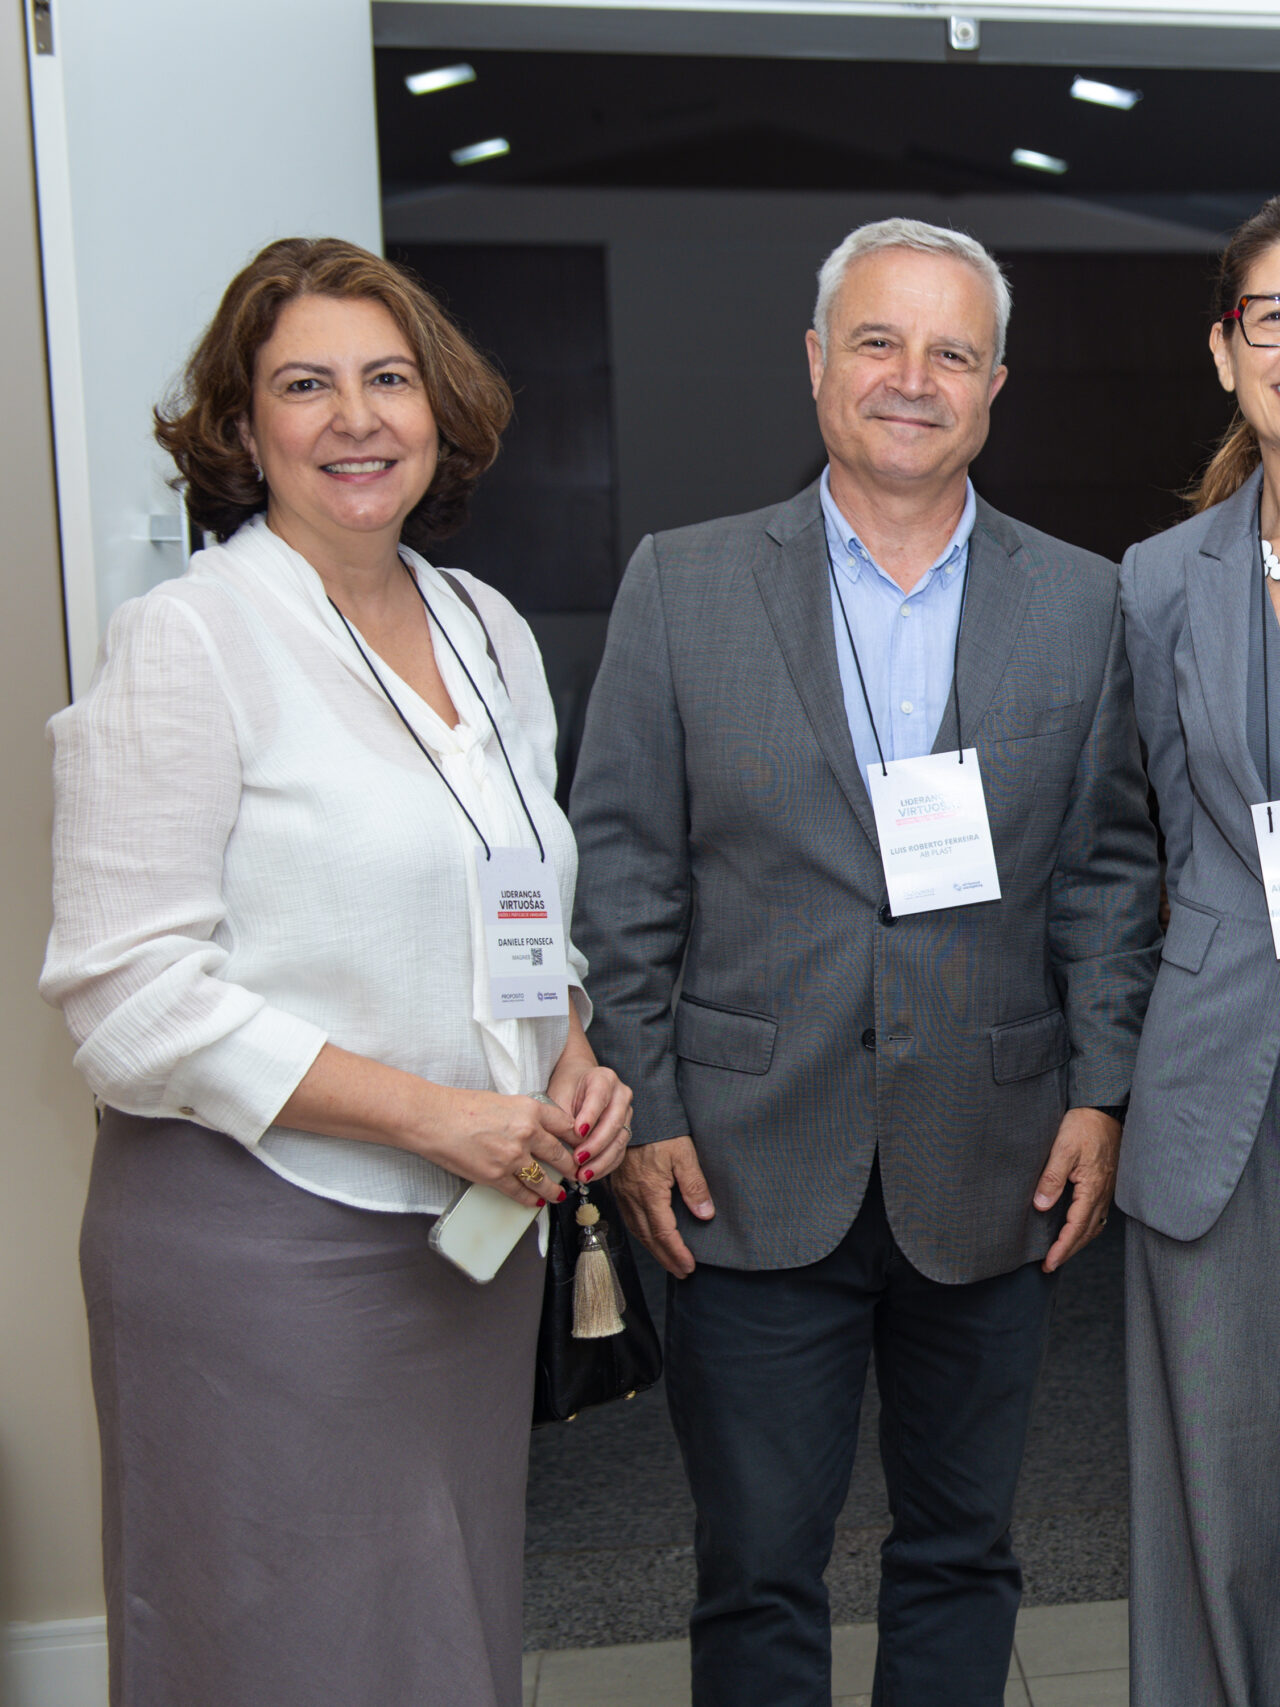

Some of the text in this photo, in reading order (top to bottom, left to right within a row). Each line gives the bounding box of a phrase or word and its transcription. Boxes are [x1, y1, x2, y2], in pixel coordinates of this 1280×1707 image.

[890, 846, 907, 855] LUIS
[908, 840, 943, 852] ROBERTO
[501, 890, 541, 900] LIDERANÇAS
[500, 900, 545, 910] VIRTUOSAS
[498, 938, 553, 946] DANIELE FONSECA
